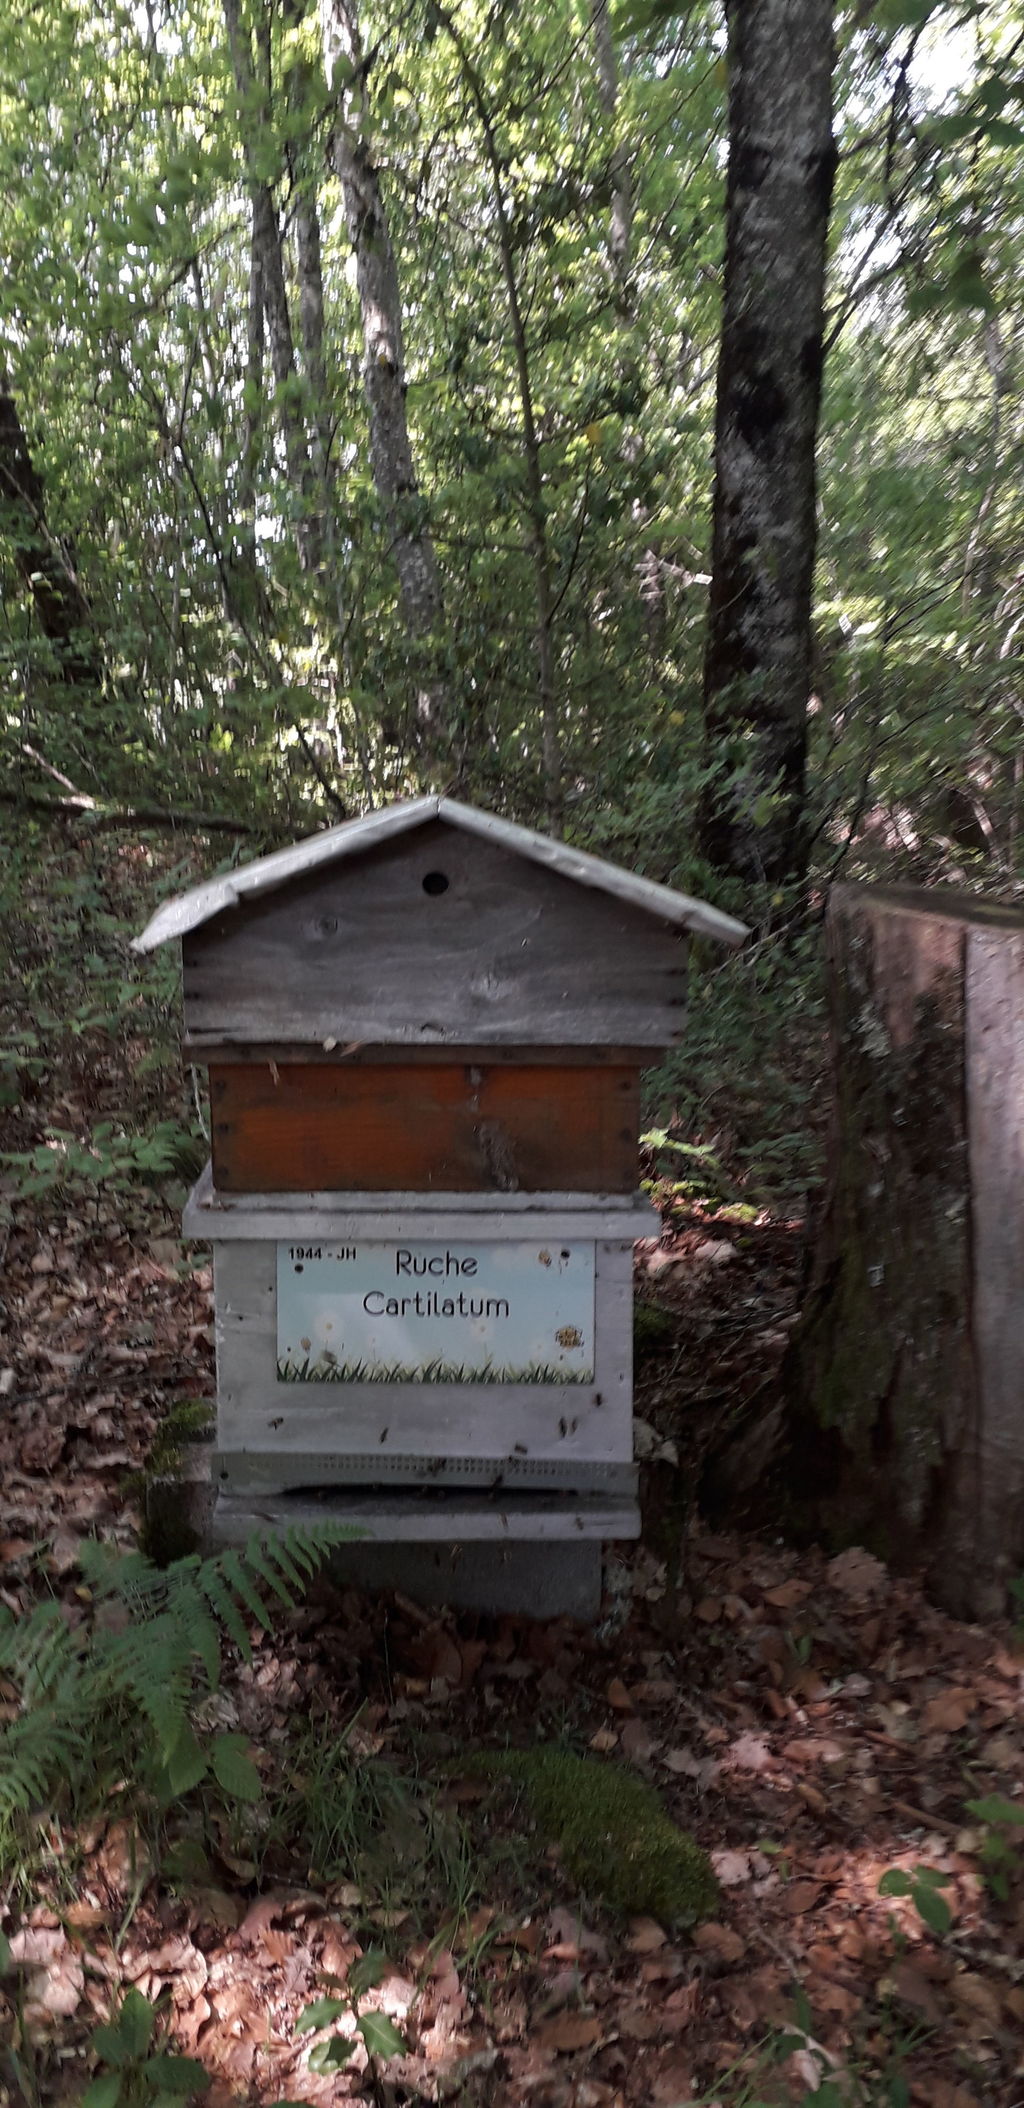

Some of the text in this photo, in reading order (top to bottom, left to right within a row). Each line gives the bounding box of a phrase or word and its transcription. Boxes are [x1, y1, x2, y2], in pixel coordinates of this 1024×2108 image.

[289, 1247, 322, 1260] 1944
[337, 1247, 357, 1260] JH
[396, 1249, 478, 1277] Ruche
[363, 1290, 510, 1318] Cartilatum
